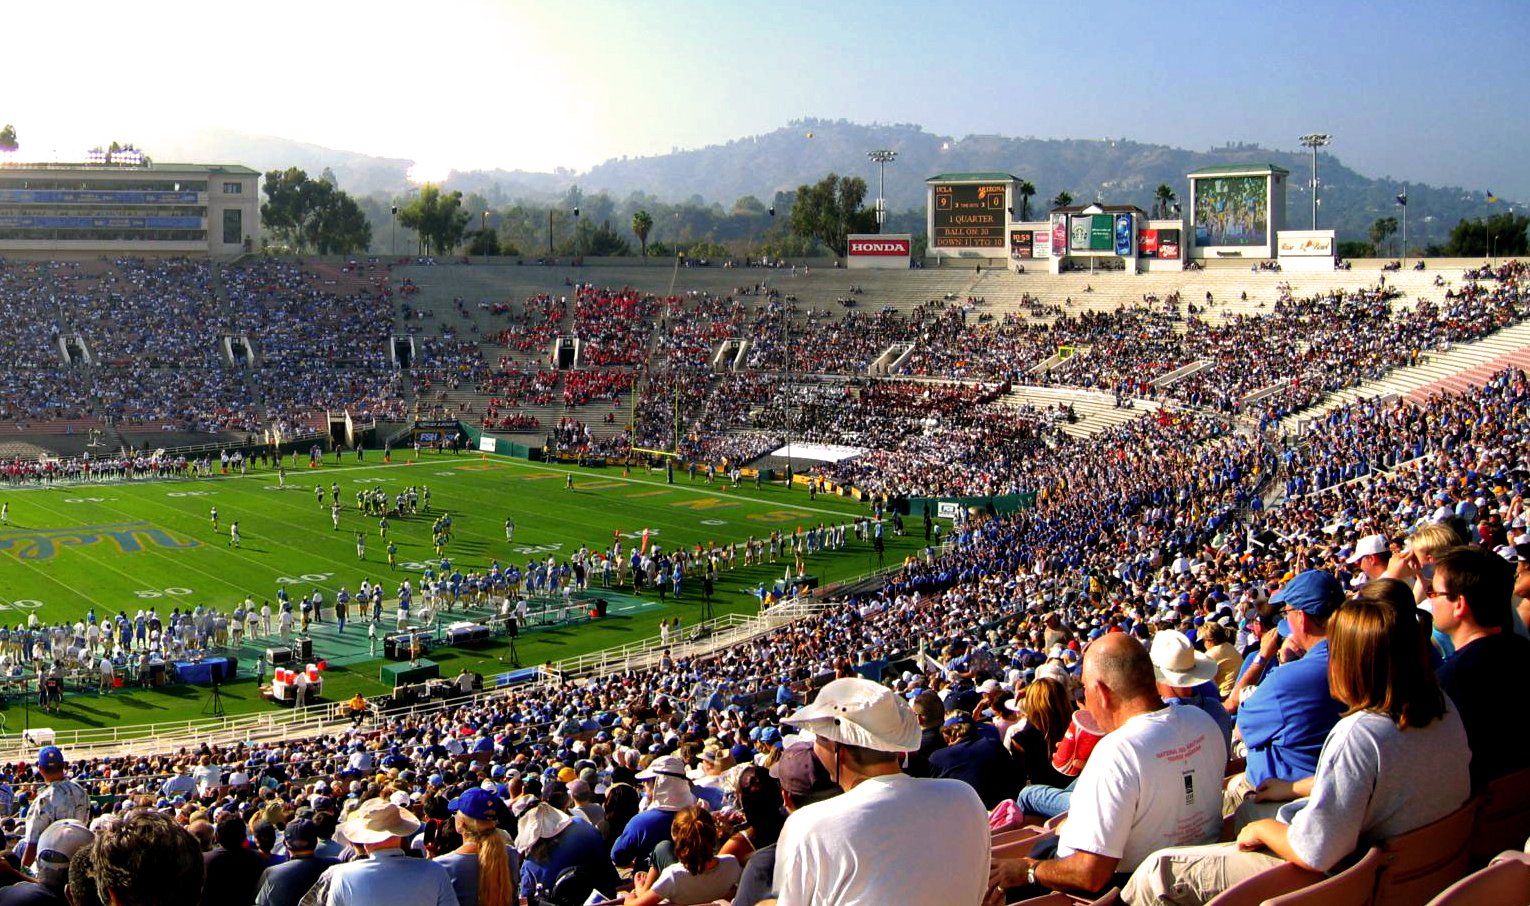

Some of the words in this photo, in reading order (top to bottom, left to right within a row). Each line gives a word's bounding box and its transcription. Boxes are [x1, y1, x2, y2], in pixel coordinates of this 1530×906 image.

[941, 197, 947, 207] 9
[993, 197, 999, 206] 0
[955, 215, 994, 225] QUARTER
[945, 228, 963, 236] BALL
[851, 243, 906, 252] HONDA
[133, 587, 193, 598] 50
